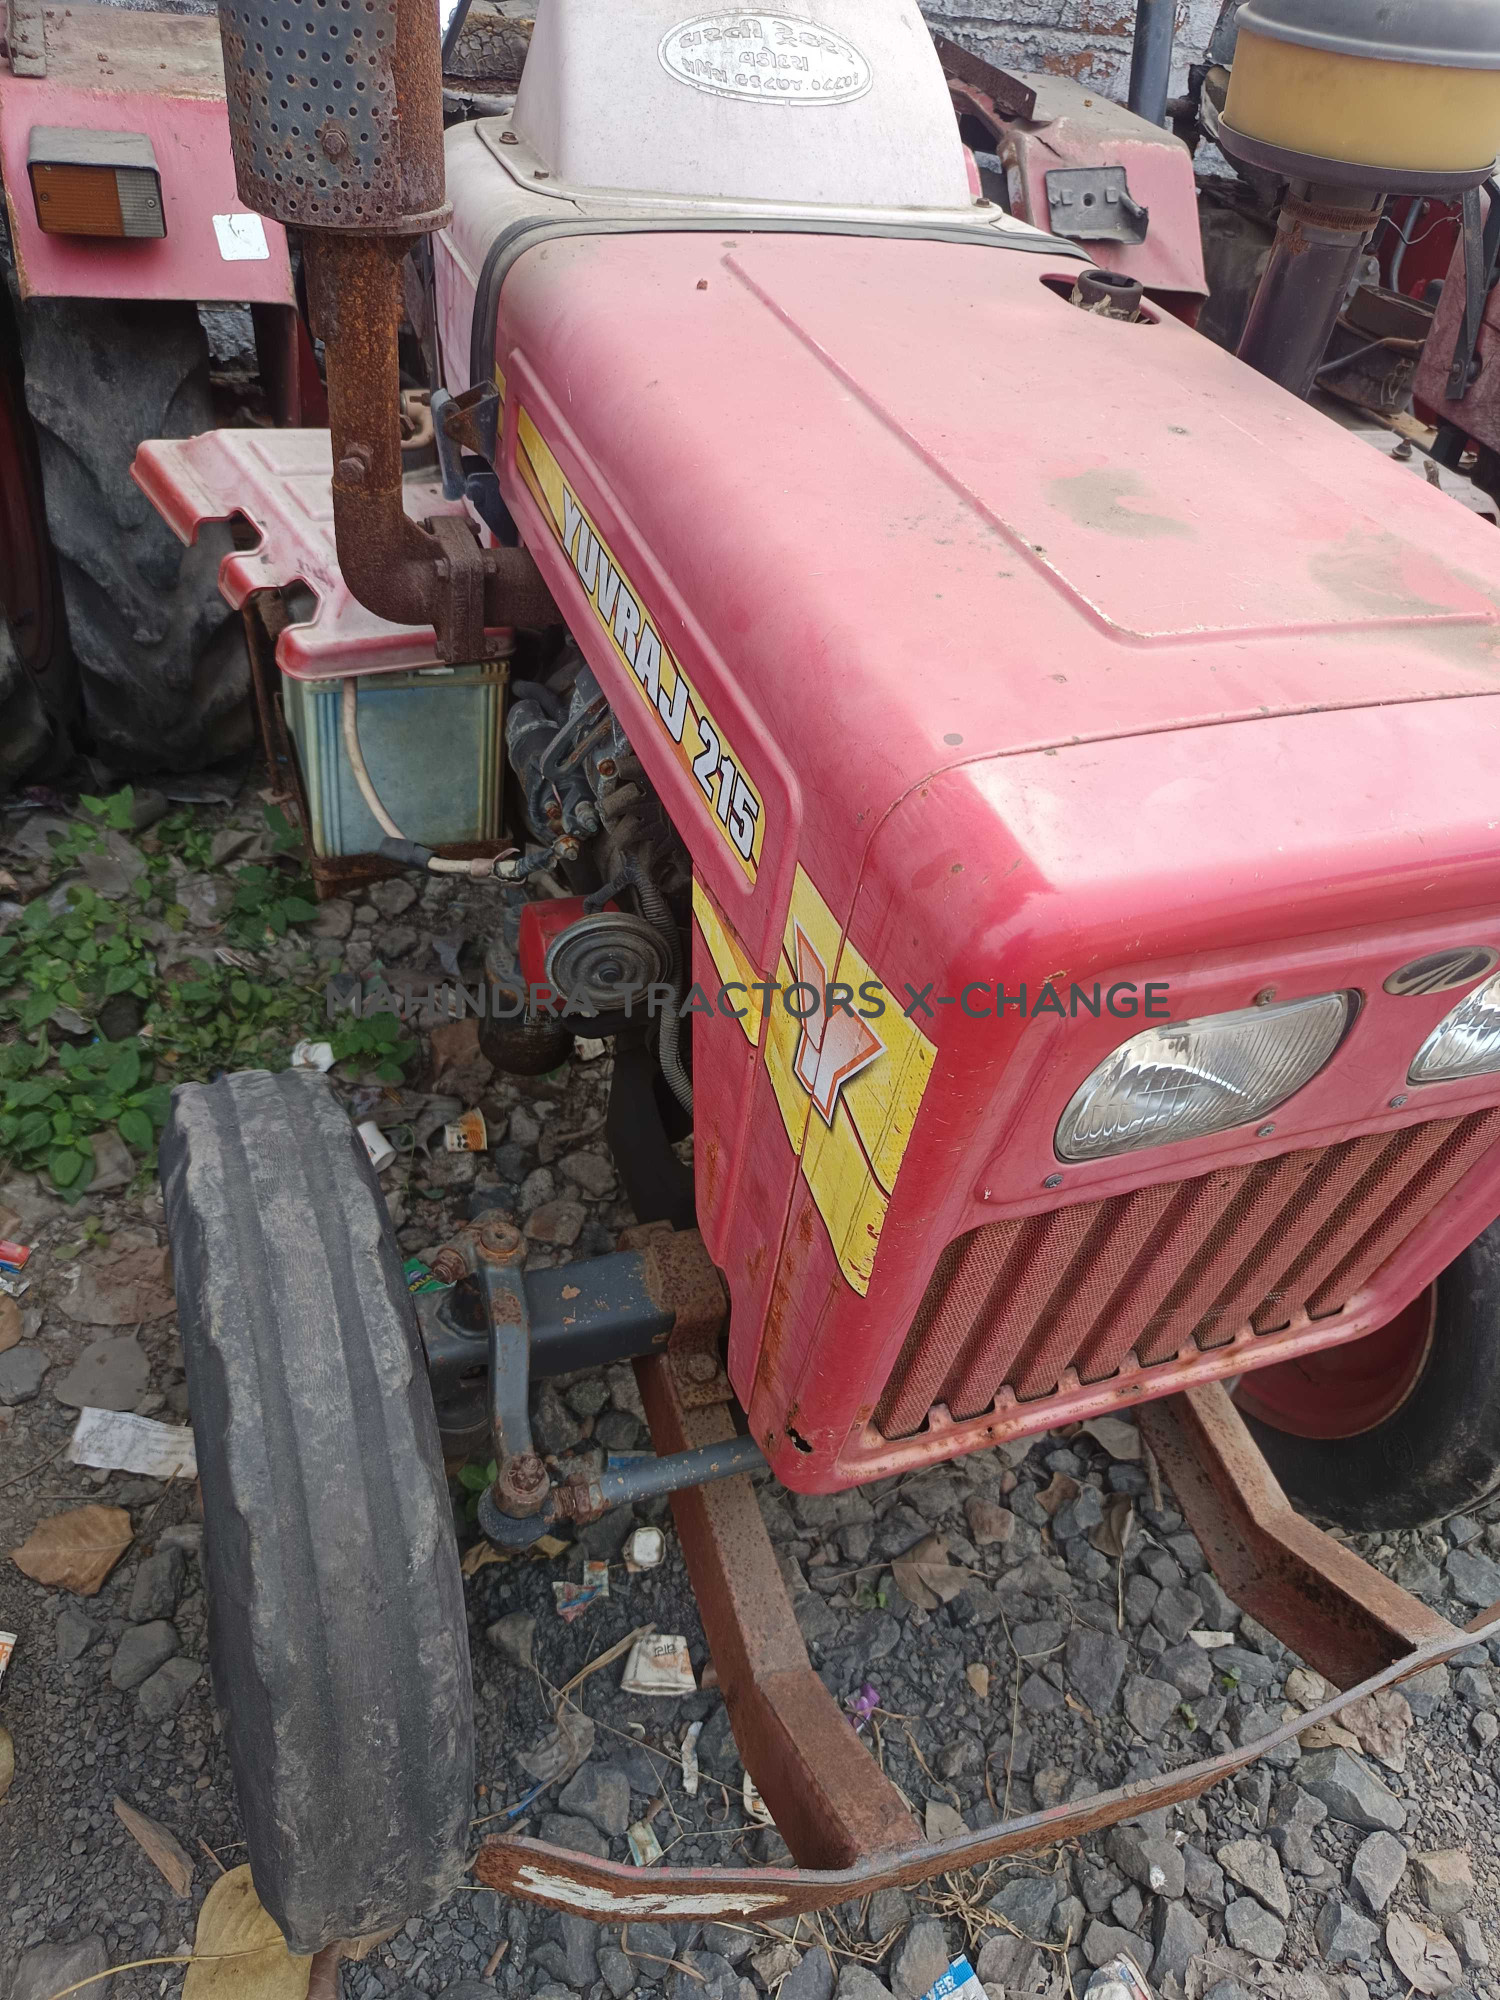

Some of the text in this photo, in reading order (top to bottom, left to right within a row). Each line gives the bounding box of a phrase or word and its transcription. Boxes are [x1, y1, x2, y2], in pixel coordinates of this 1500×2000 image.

[738, 46, 810, 72] વડોદરા
[562, 485, 760, 862] YUVRAJ 215
